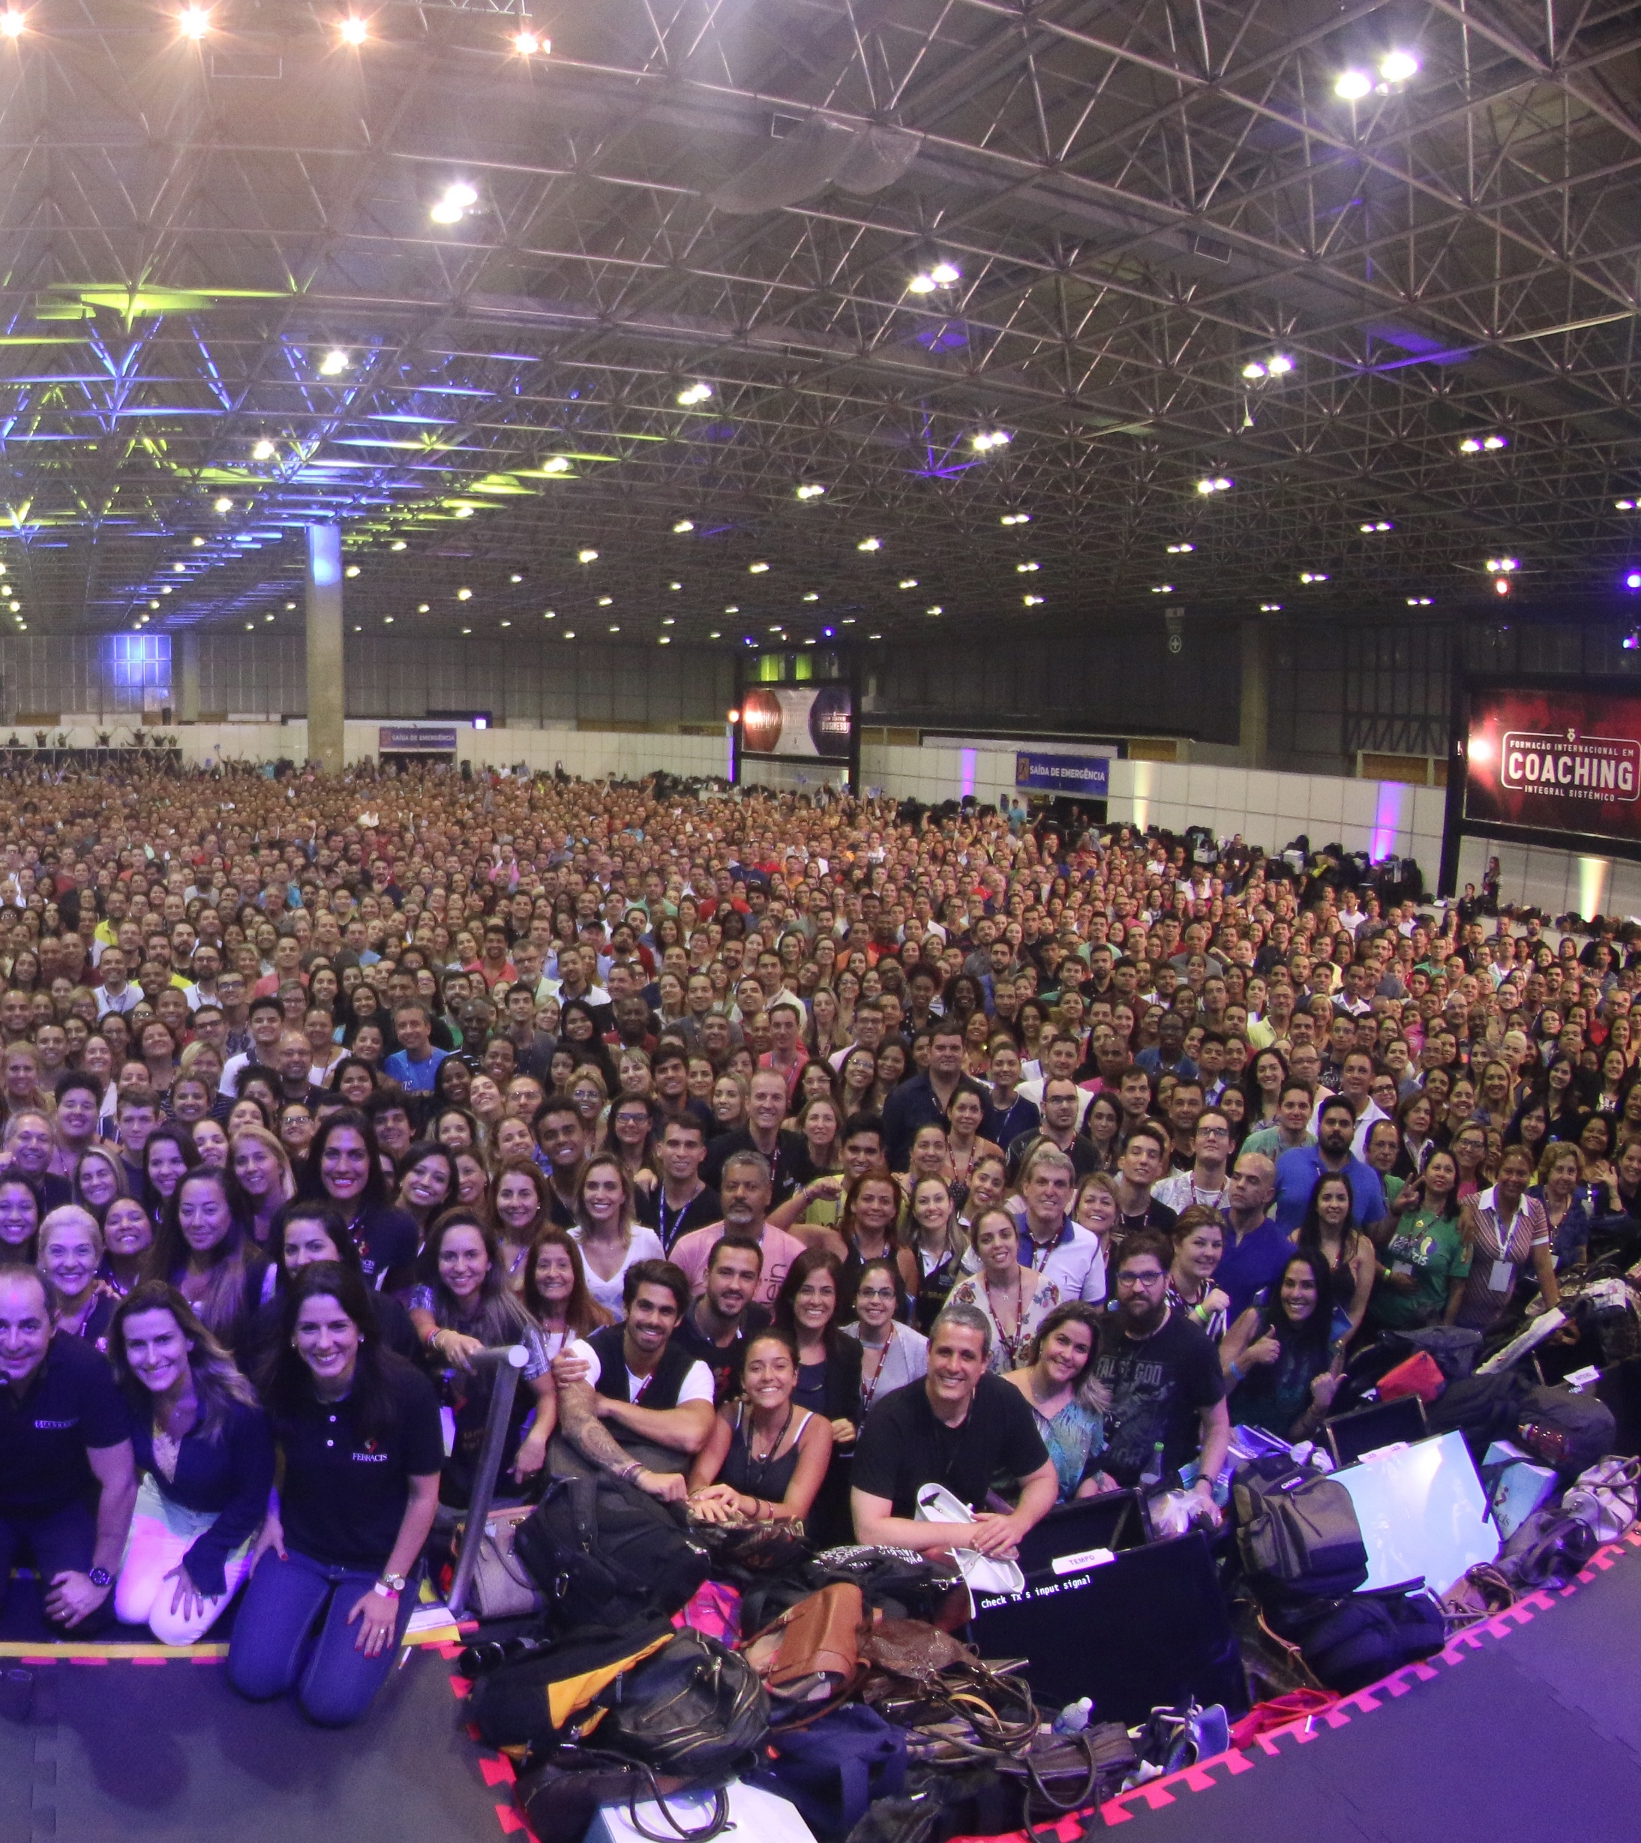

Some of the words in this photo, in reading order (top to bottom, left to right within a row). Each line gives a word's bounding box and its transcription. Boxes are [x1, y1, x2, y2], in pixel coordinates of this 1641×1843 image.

[1510, 740, 1551, 751] FORMAÇÃO
[1554, 743, 1618, 756] INTERNACIONAL
[1622, 749, 1634, 757] EM
[1030, 764, 1049, 776] SAÍDA
[1050, 768, 1060, 777] DE
[1061, 768, 1105, 781] EMERGÊNCIA
[1508, 752, 1633, 791] COACHING
[1524, 785, 1565, 796] INTEGRAL
[1569, 789, 1615, 802] SISTÊMICO
[1134, 1362, 1163, 1386] GOD
[1068, 1554, 1096, 1566] TEMPO
[1035, 1584, 1060, 1596] input
[1062, 1574, 1091, 1589] signal
